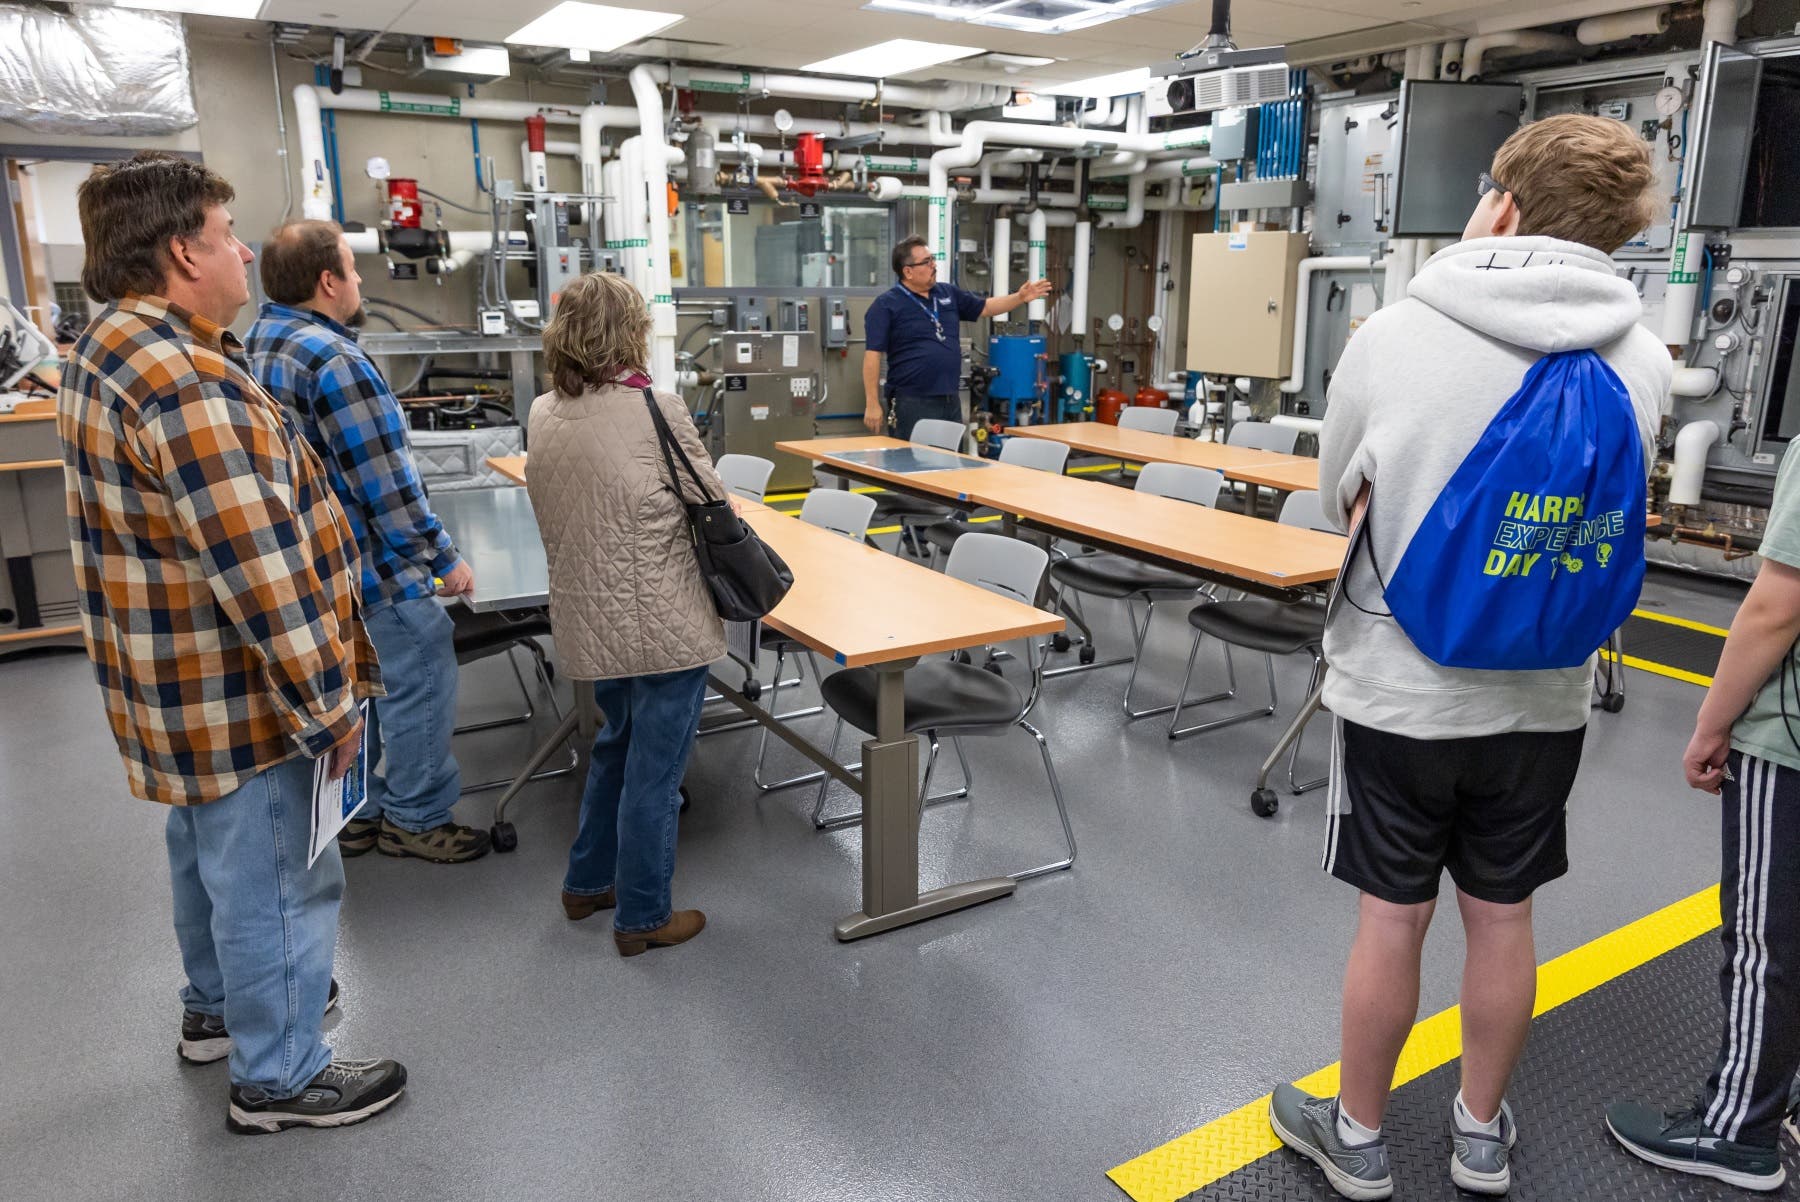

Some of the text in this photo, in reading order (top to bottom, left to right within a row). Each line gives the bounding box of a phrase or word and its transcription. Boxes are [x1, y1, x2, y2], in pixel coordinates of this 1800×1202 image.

[1673, 250, 1686, 270] STEAM
[1493, 510, 1624, 551] EXPEENCE
[1483, 549, 1542, 577] DAY
